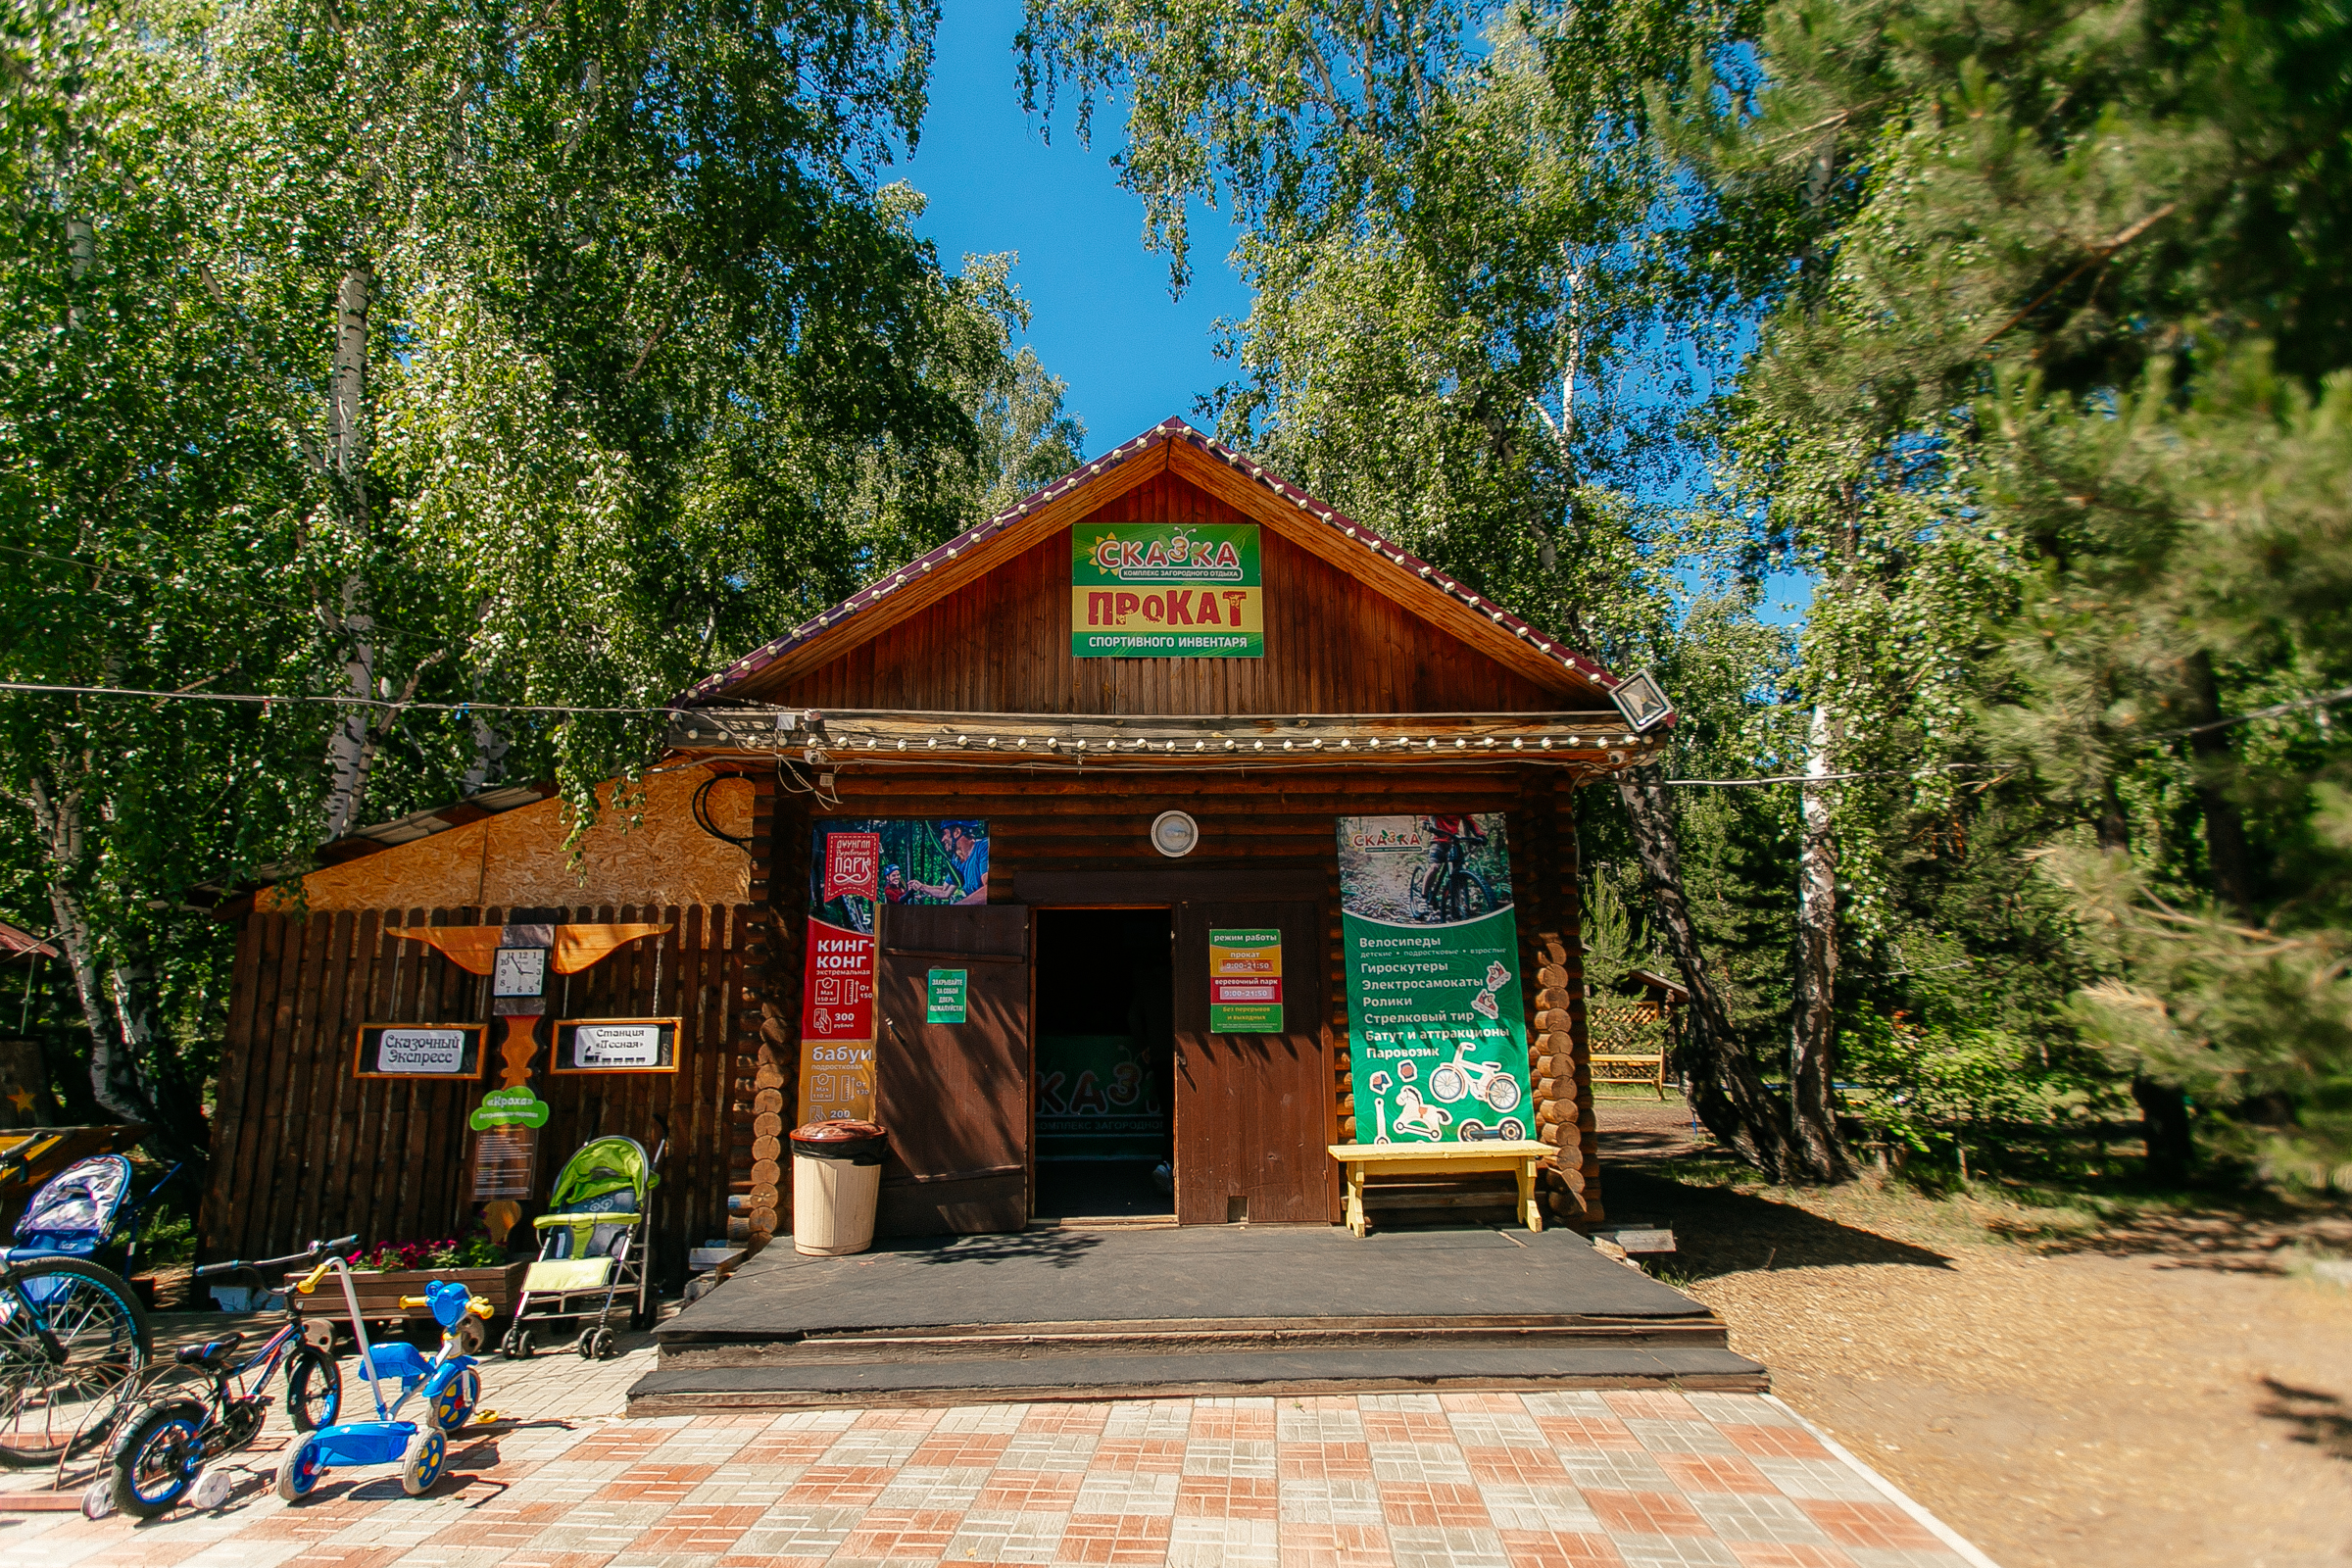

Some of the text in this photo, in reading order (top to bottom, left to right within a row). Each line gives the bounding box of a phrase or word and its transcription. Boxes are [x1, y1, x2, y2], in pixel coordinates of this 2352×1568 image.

[1097, 536, 1240, 567] СКАЗКА
[1088, 590, 1247, 627] ПРОКАТ
[1089, 637, 1248, 648] СПОРТИВНОГО ИНВЕНТАРЯ
[1353, 831, 1422, 847] СКАЗКА
[834, 857, 872, 874] ПАРК
[862, 913, 872, 925] 5
[1359, 937, 1442, 948] Велосипеды
[1360, 962, 1448, 974] Гироскутеры
[1362, 978, 1484, 991] Электросамокаты
[1363, 997, 1413, 1007] Ролики
[834, 1012, 855, 1021] 300
[1364, 1010, 1475, 1025] Стрелковый тир
[1365, 1028, 1510, 1043] Батут и аттракционы
[385, 1035, 460, 1052] Сказочный
[388, 1050, 453, 1066] Экспресс
[1366, 1047, 1440, 1059] Паровозик
[830, 1109, 851, 1118] 200
